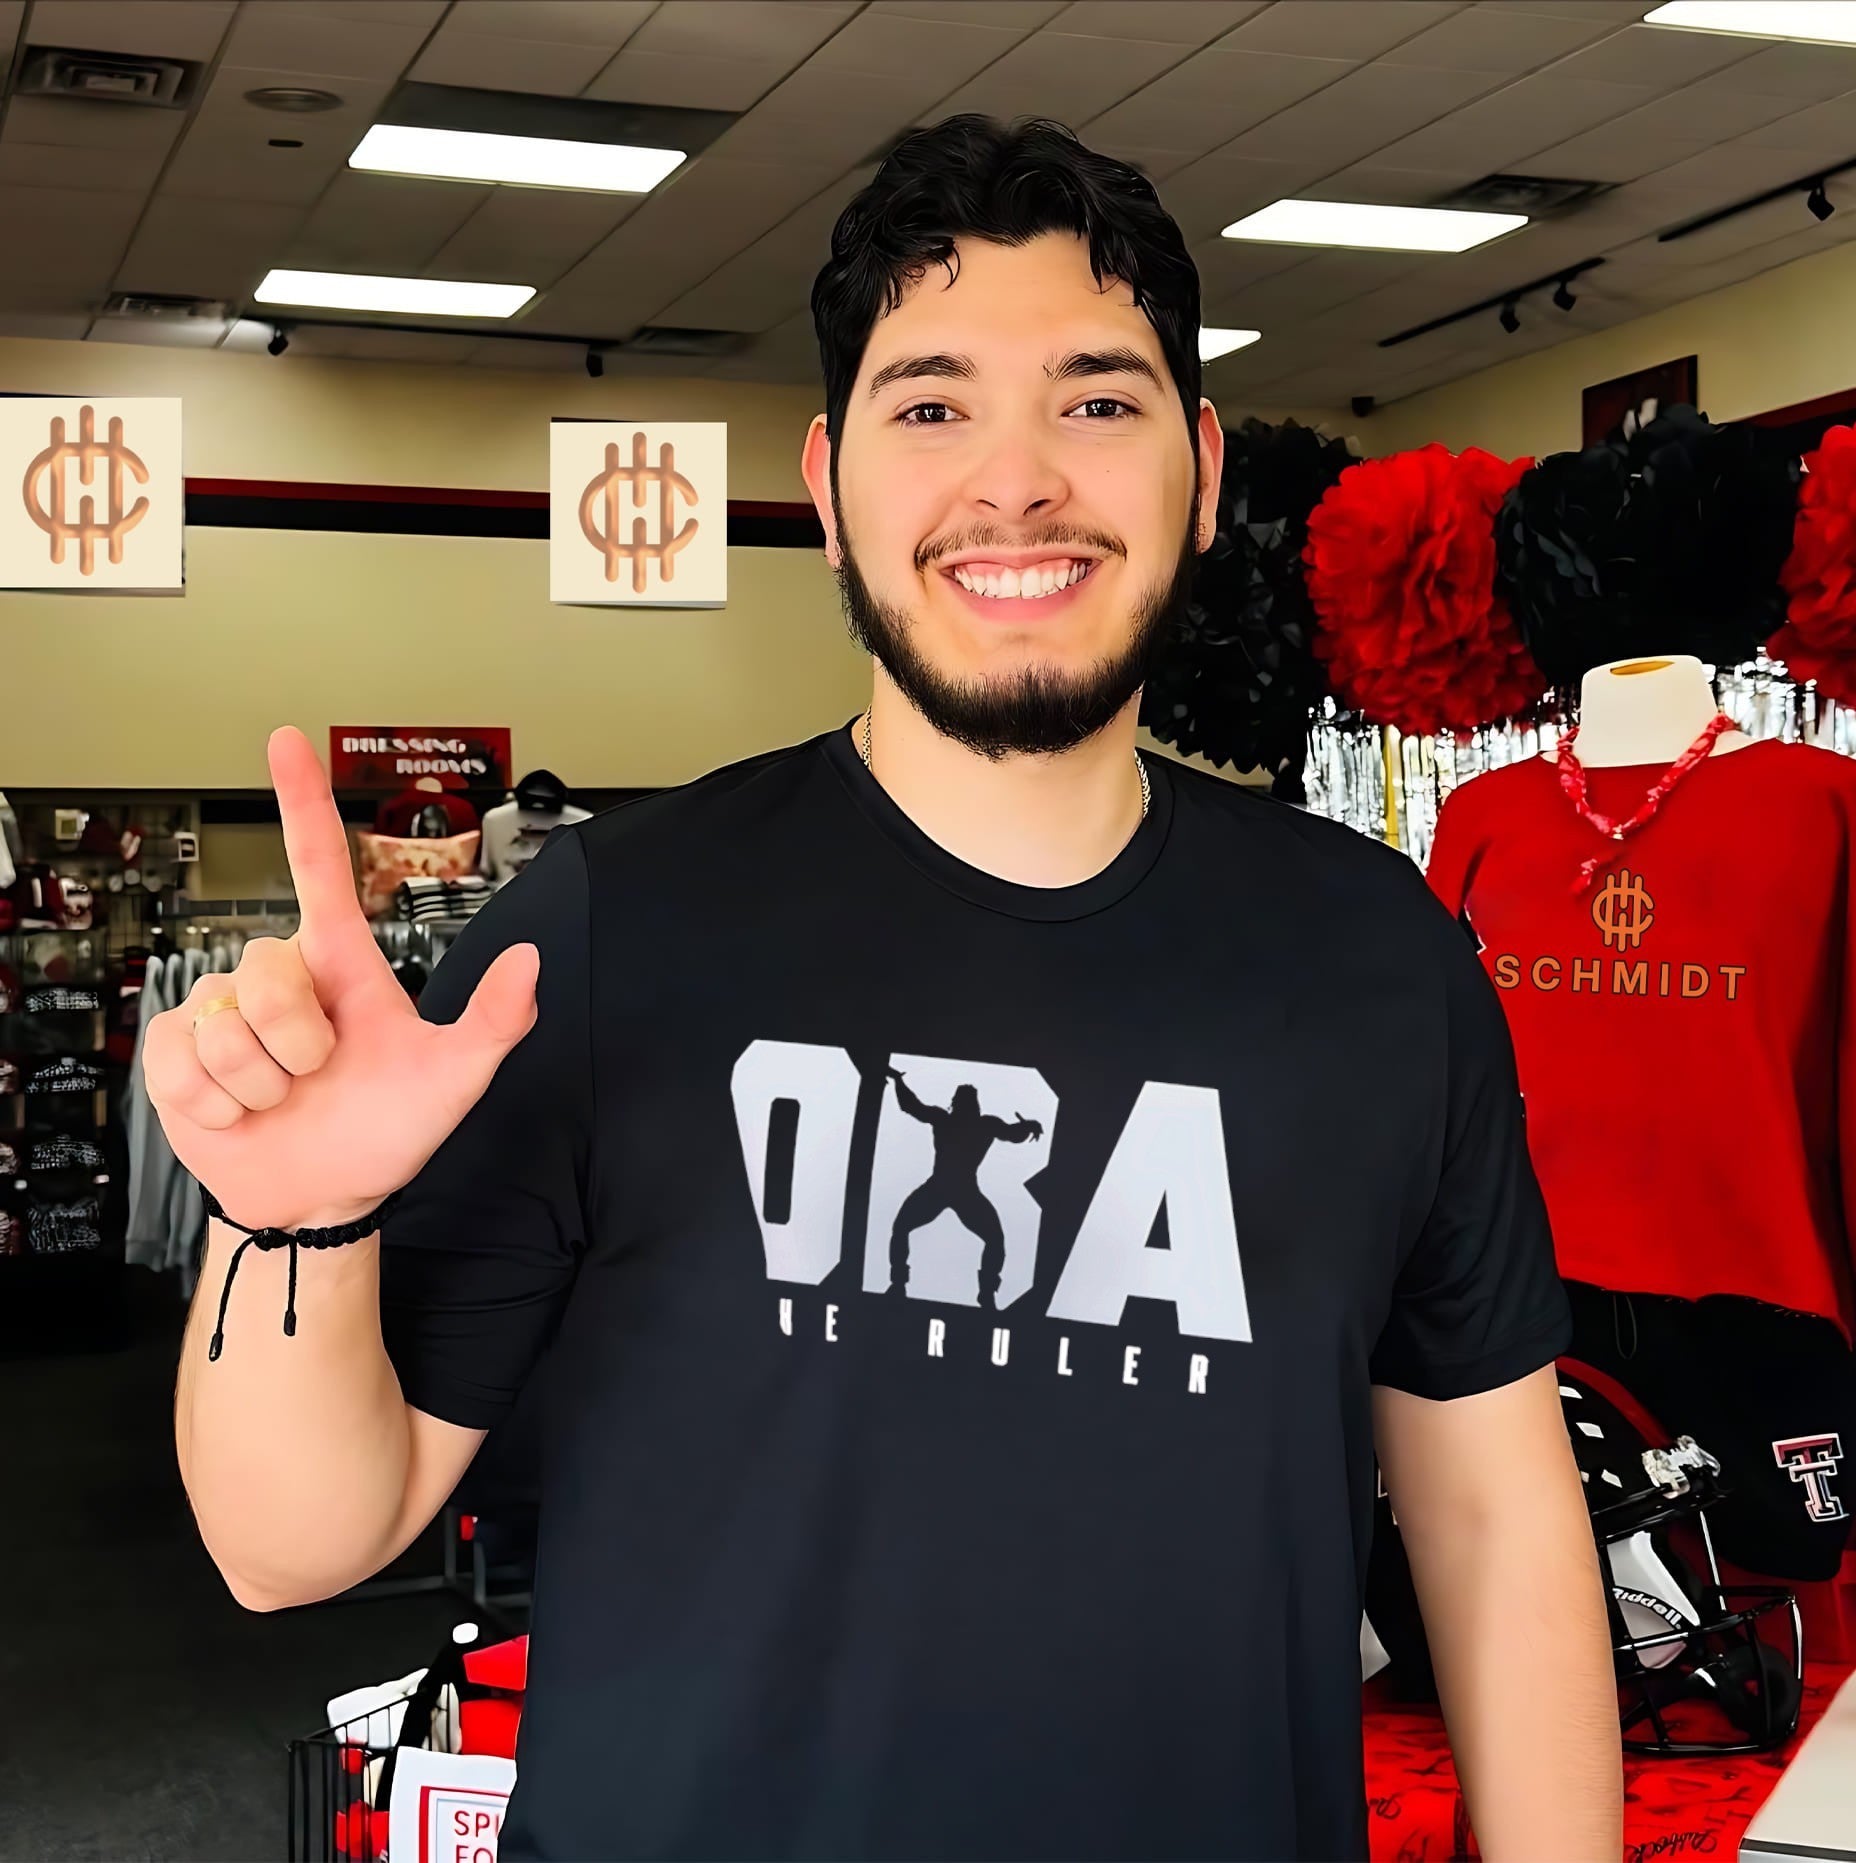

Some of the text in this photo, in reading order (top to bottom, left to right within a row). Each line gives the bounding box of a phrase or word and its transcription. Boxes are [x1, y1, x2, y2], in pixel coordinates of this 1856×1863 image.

[342, 737, 467, 753] DRESSING
[396, 758, 487, 775] ROOMS
[1494, 953, 1747, 1000] SCHMIDT
[927, 1318, 1210, 1394] RULER
